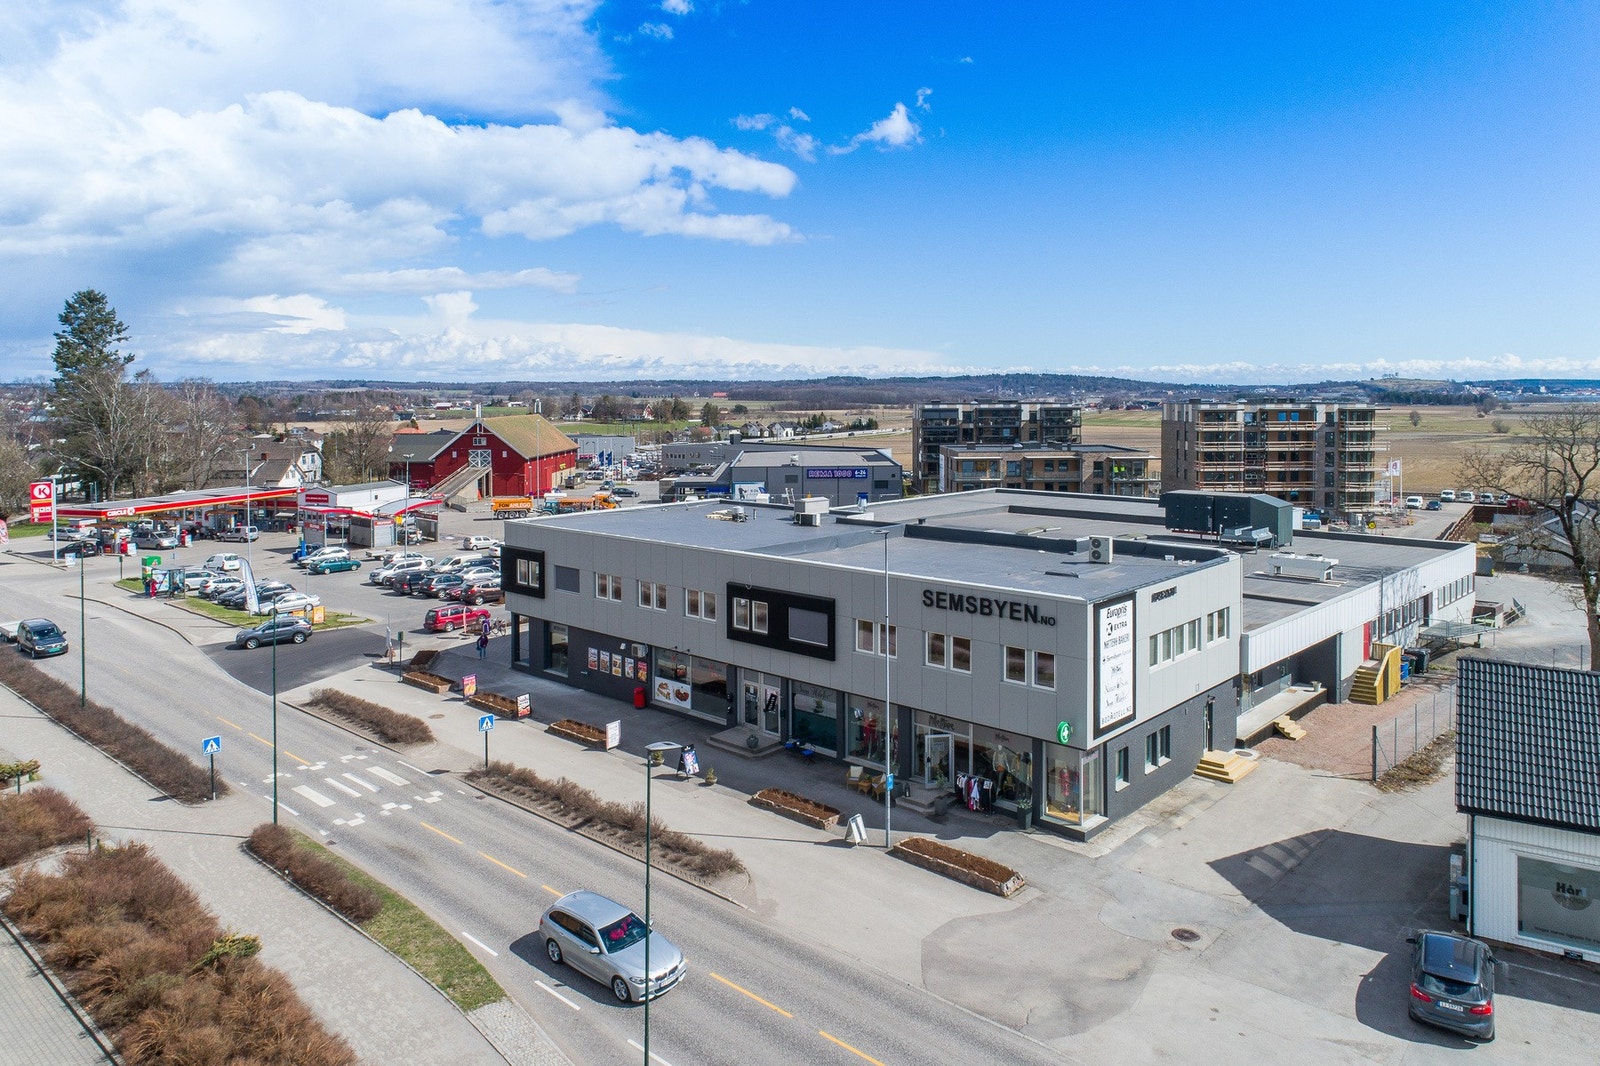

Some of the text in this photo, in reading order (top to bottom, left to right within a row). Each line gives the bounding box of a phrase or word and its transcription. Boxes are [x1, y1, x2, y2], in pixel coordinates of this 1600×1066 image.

[808, 469, 852, 478] REMA 1000
[1106, 604, 1127, 618] Europris
[1556, 882, 1582, 896] Hår
